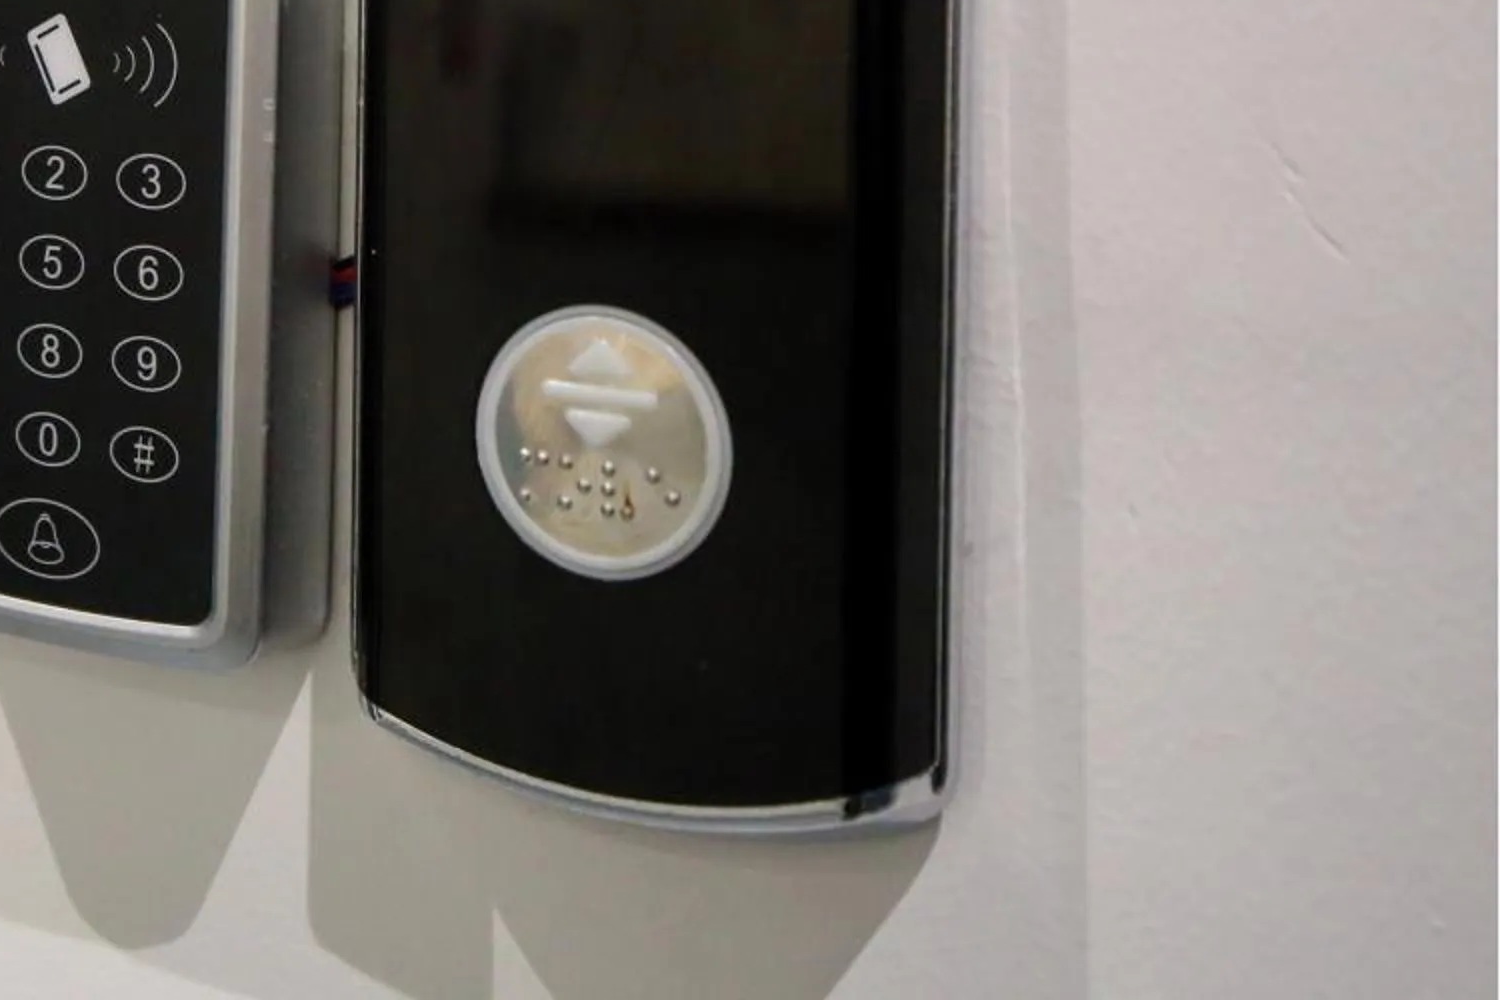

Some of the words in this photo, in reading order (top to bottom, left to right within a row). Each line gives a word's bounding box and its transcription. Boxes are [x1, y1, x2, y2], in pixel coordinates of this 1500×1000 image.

[45, 155, 65, 190] 2
[141, 163, 161, 199] 3
[43, 245, 62, 279] 5
[138, 255, 159, 291] 6
[41, 333, 60, 368] 8
[137, 345, 157, 381] 9
[39, 422, 58, 457] 0
[133, 436, 155, 473] #
